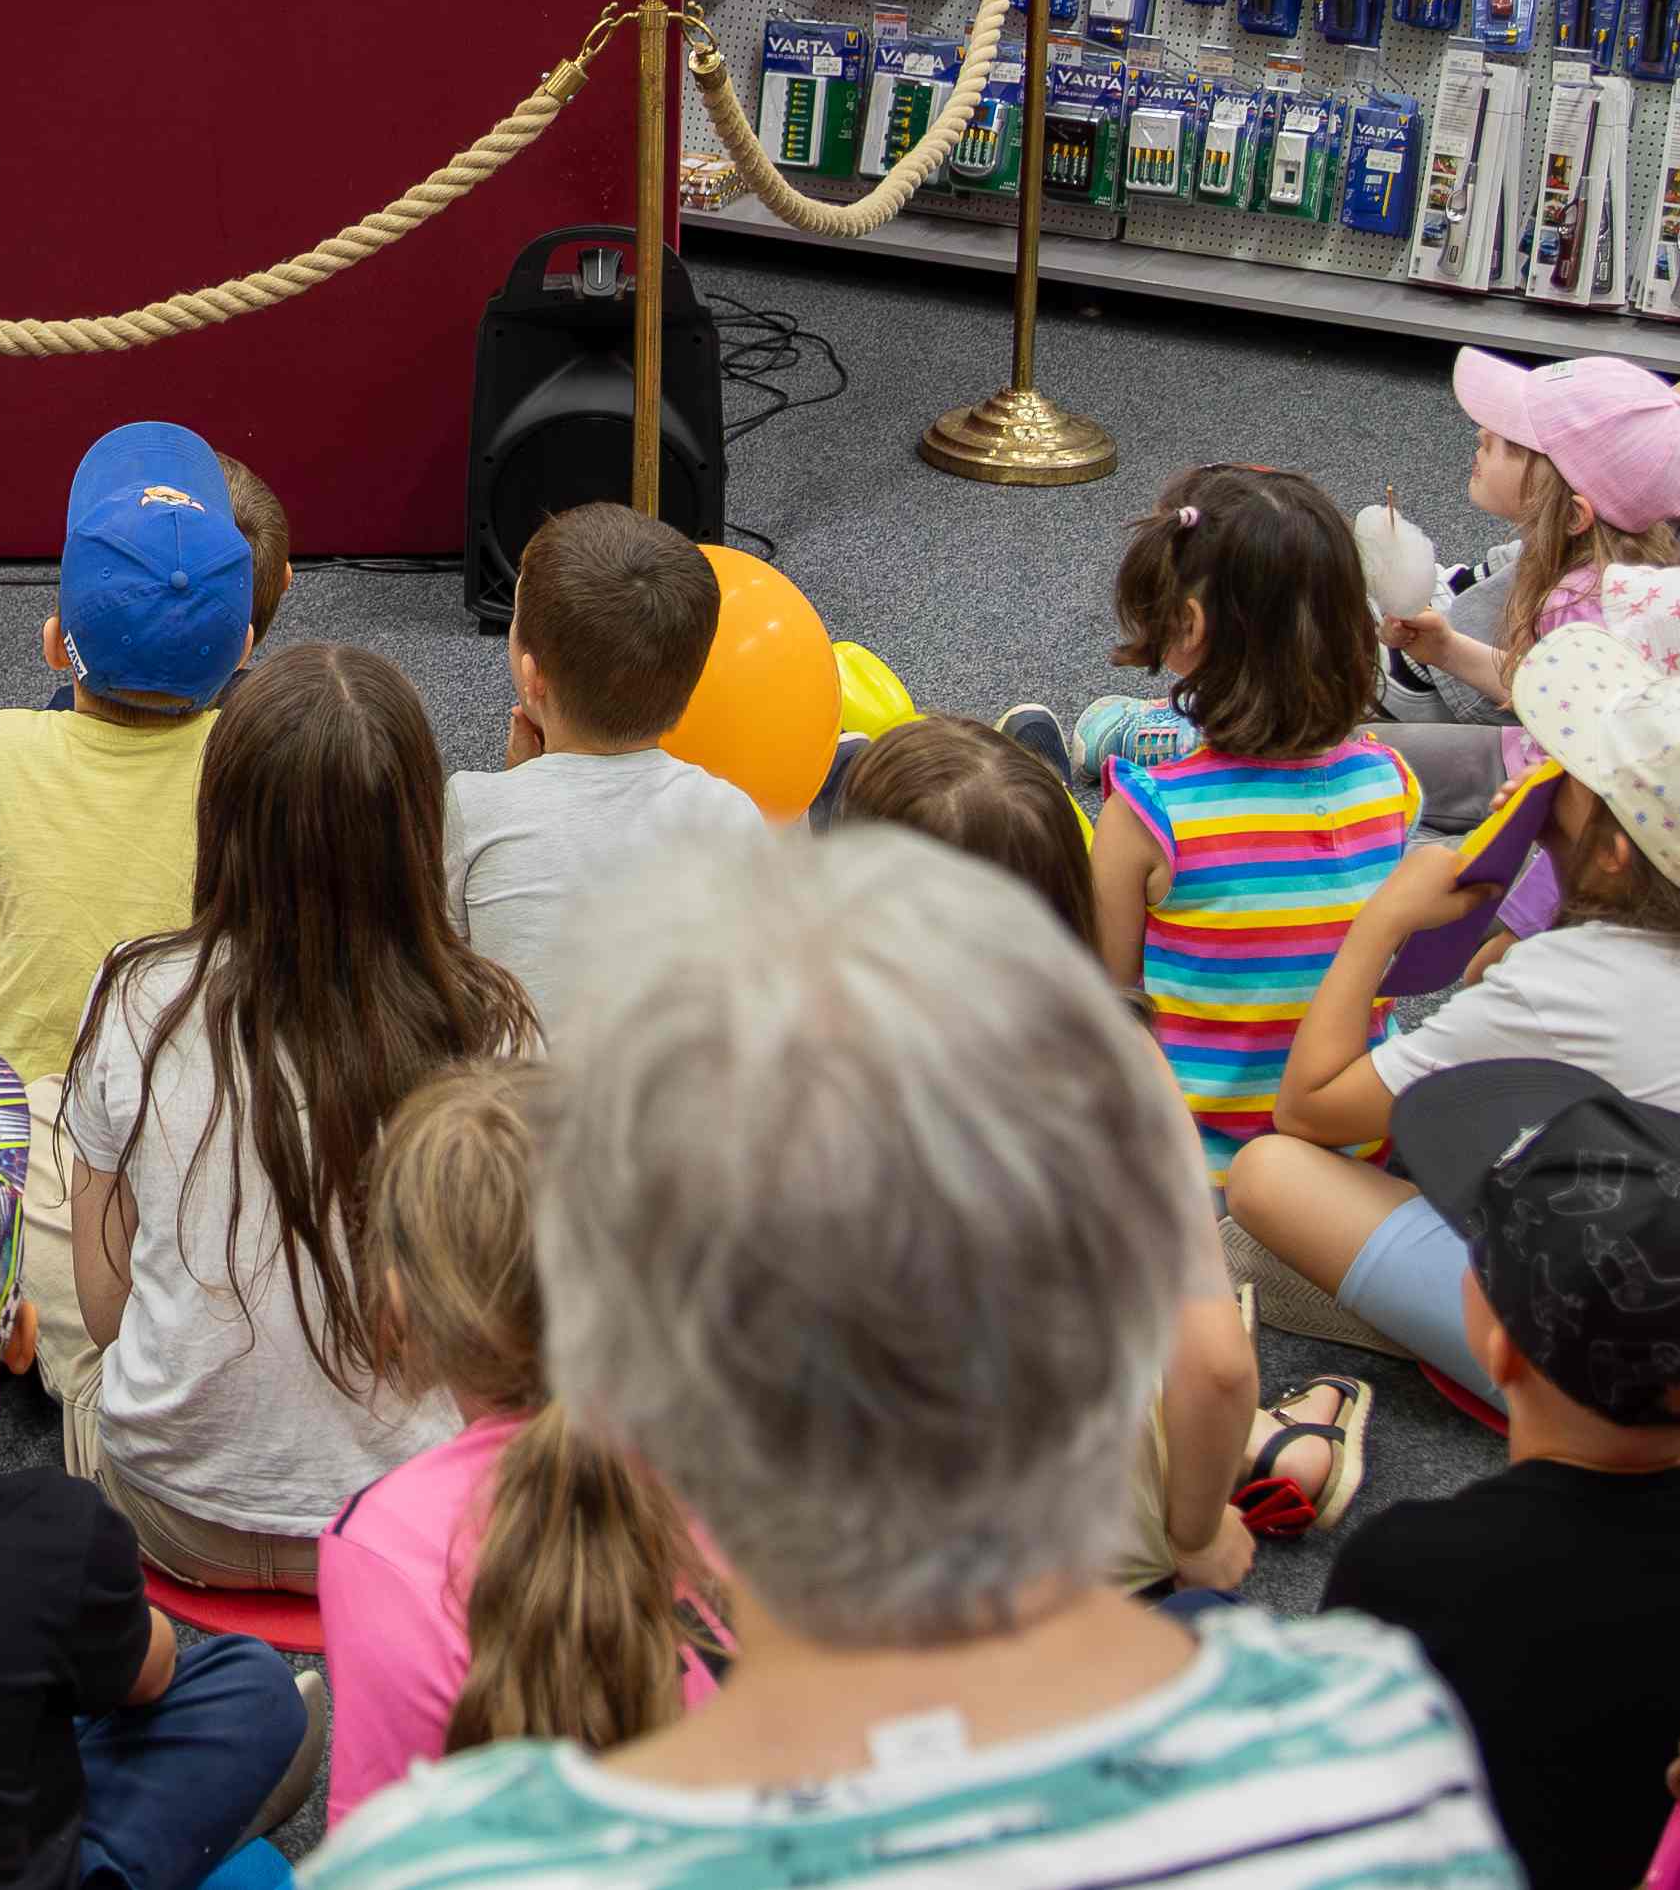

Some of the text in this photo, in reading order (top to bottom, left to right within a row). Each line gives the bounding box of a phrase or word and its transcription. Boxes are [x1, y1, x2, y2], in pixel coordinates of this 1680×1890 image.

[767, 37, 836, 58] VARTA
[1055, 71, 1123, 92] VARTA
[1140, 86, 1196, 105] VARTA
[1355, 122, 1408, 142] VARTA
